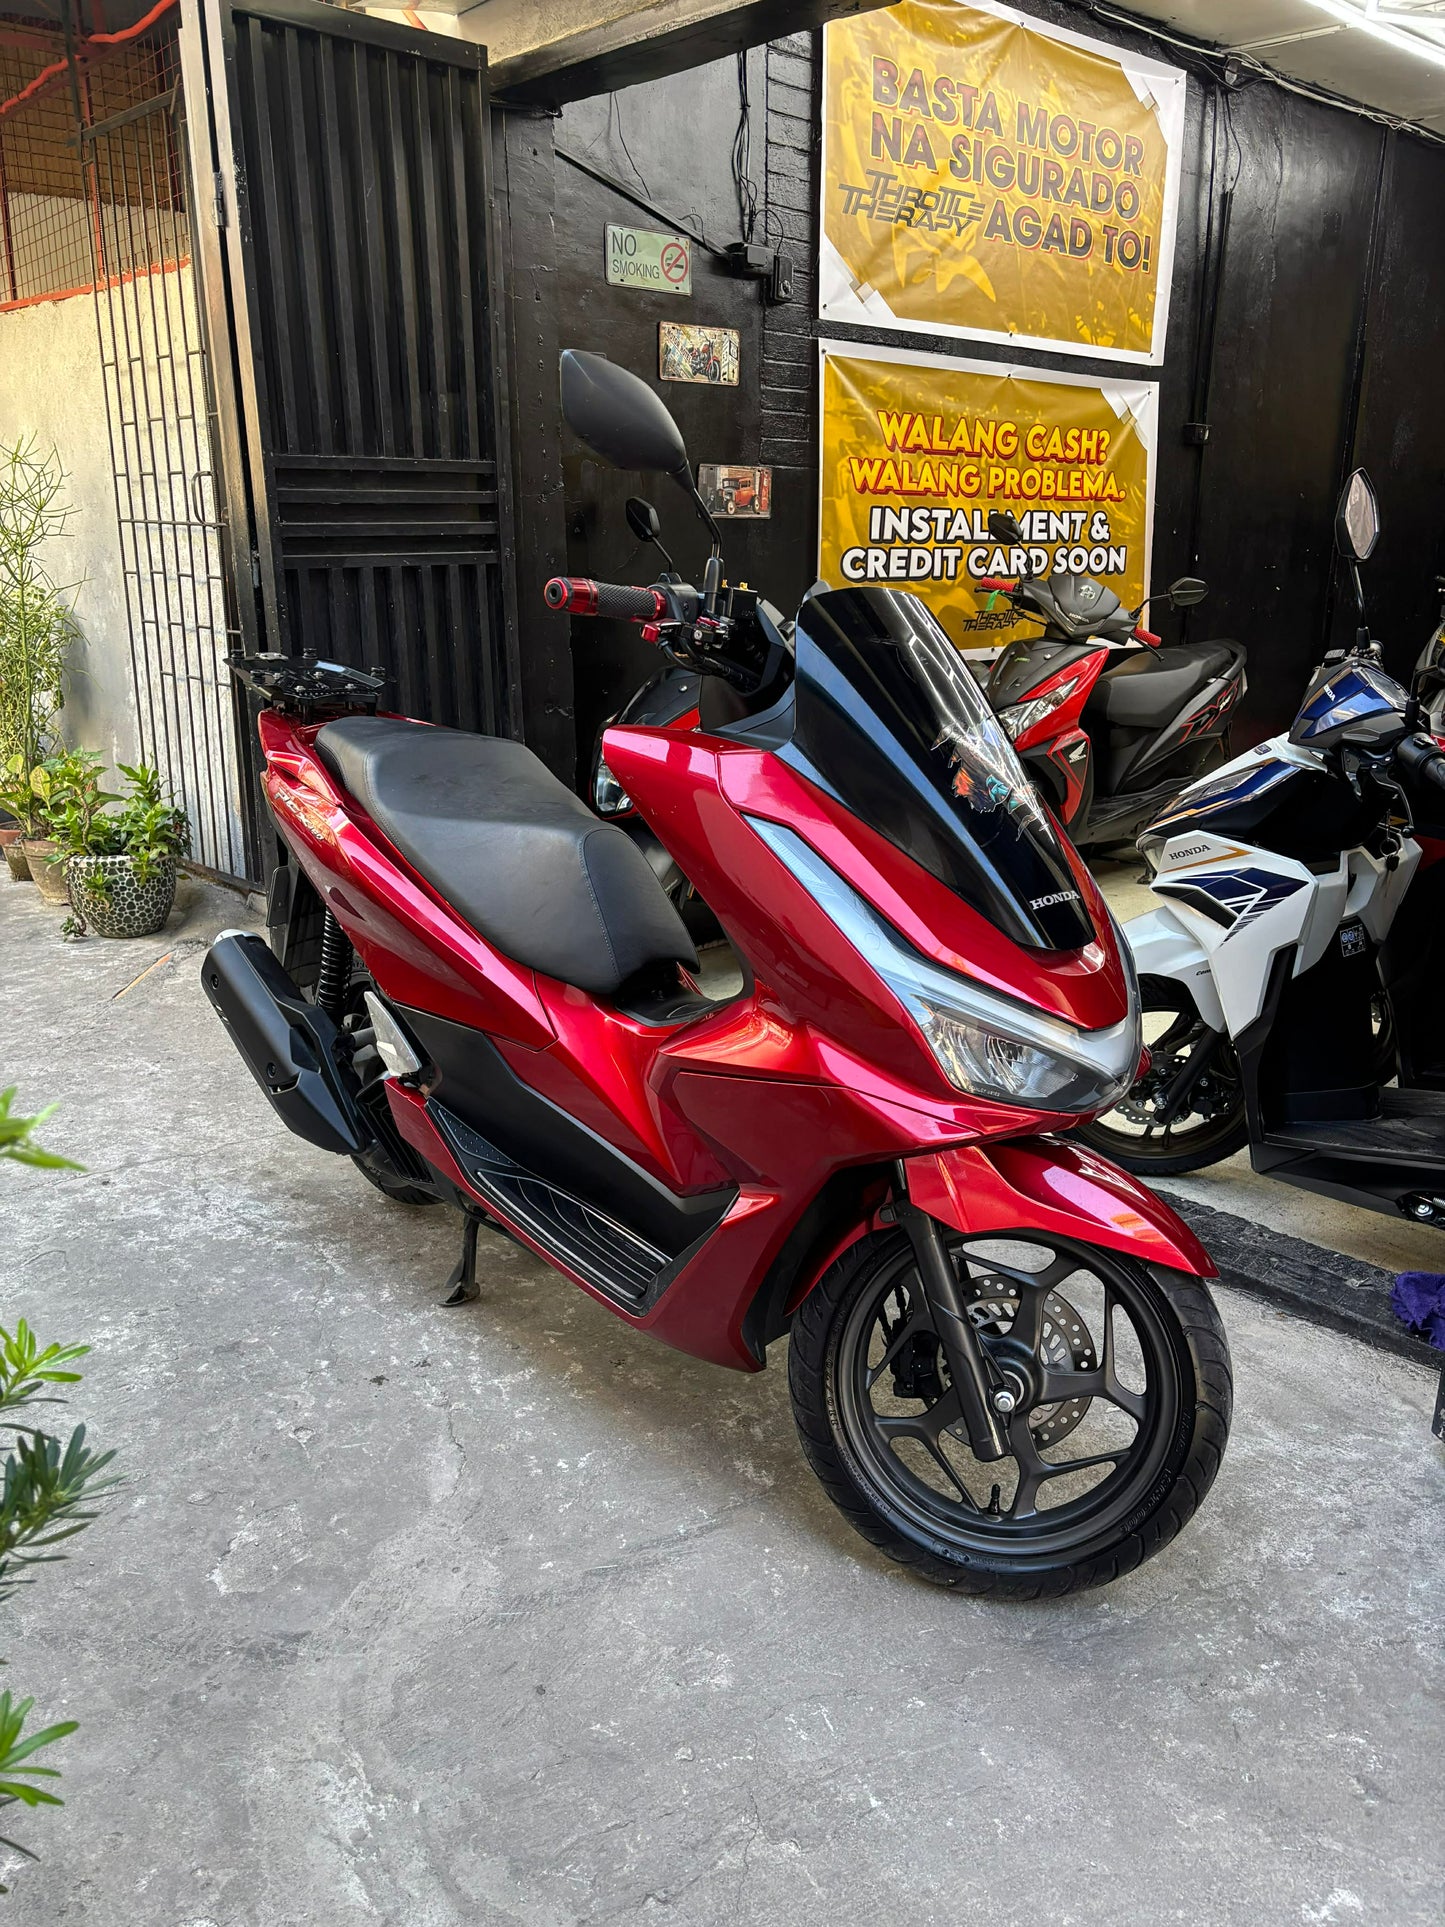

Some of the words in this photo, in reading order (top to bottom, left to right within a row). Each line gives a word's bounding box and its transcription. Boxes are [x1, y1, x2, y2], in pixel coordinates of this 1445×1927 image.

[871, 55, 1005, 140] BASTA
[1015, 101, 1145, 178] MOTOR
[870, 112, 938, 174] NA
[949, 134, 1141, 221] SIGURADO
[838, 183, 972, 237] THERAPY
[612, 231, 637, 257] NO
[983, 199, 1094, 260] AGAD
[1101, 225, 1152, 273] TO!
[612, 258, 660, 279] SMOKING
[877, 410, 1019, 457] WALANG
[1026, 424, 1110, 465] CASH?
[849, 458, 981, 497] WALANG
[987, 467, 1126, 502] PROBLEMA.
[870, 507, 1087, 544] INSTALMENT
[1091, 512, 1111, 542] &
[842, 546, 963, 581] CREDIT
[967, 546, 1049, 577] CARD
[1052, 545, 1127, 576] SOON
[1168, 844, 1211, 860] HONDA
[1029, 890, 1081, 910] HONDA
